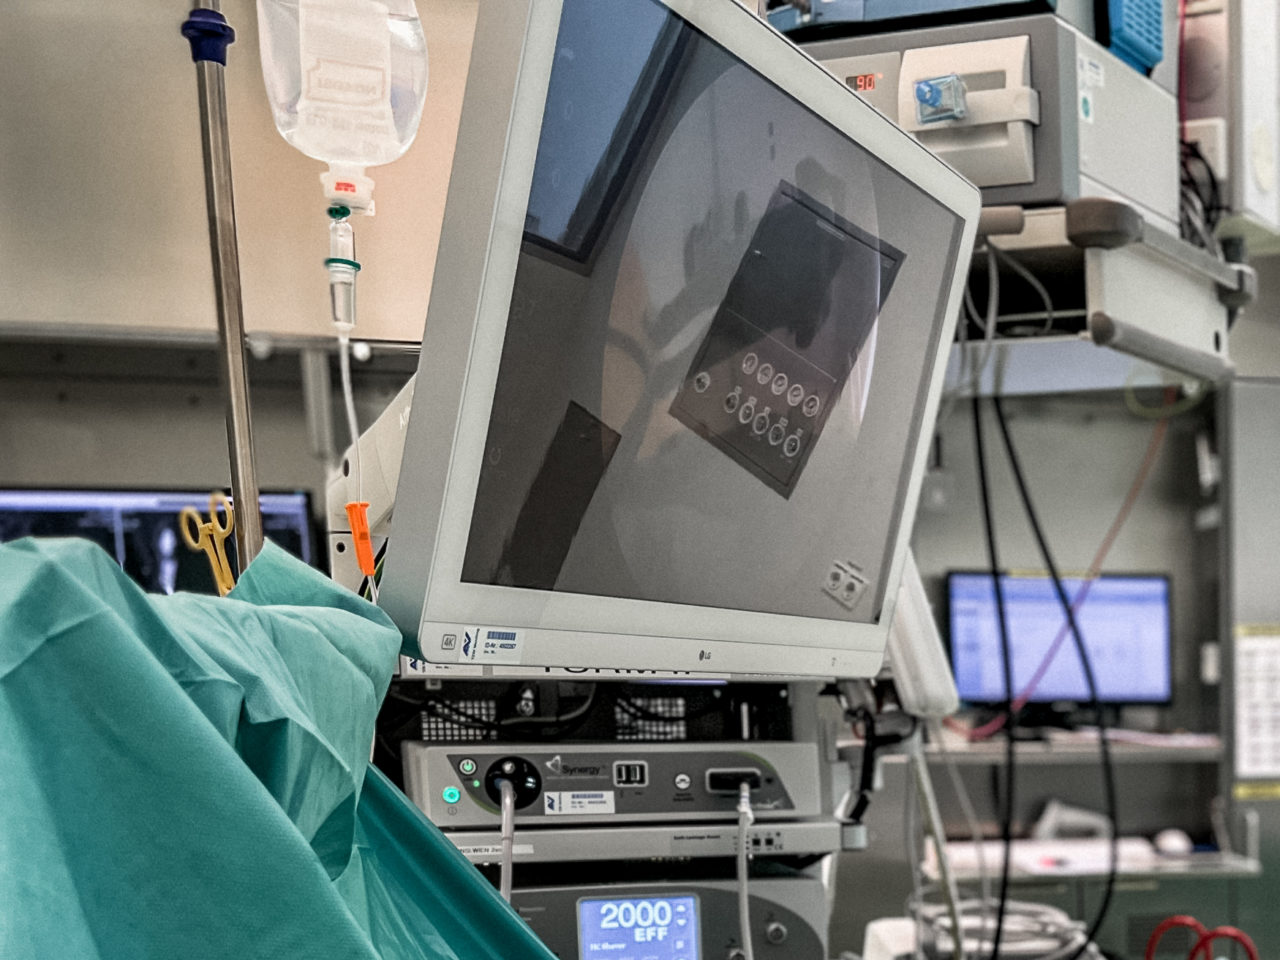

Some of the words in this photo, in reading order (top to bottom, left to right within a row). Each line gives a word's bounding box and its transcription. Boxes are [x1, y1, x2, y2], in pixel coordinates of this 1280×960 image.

[856, 75, 875, 91] 90
[562, 764, 601, 776] Synergy
[600, 901, 672, 929] 2000
[634, 926, 668, 942] EFF
